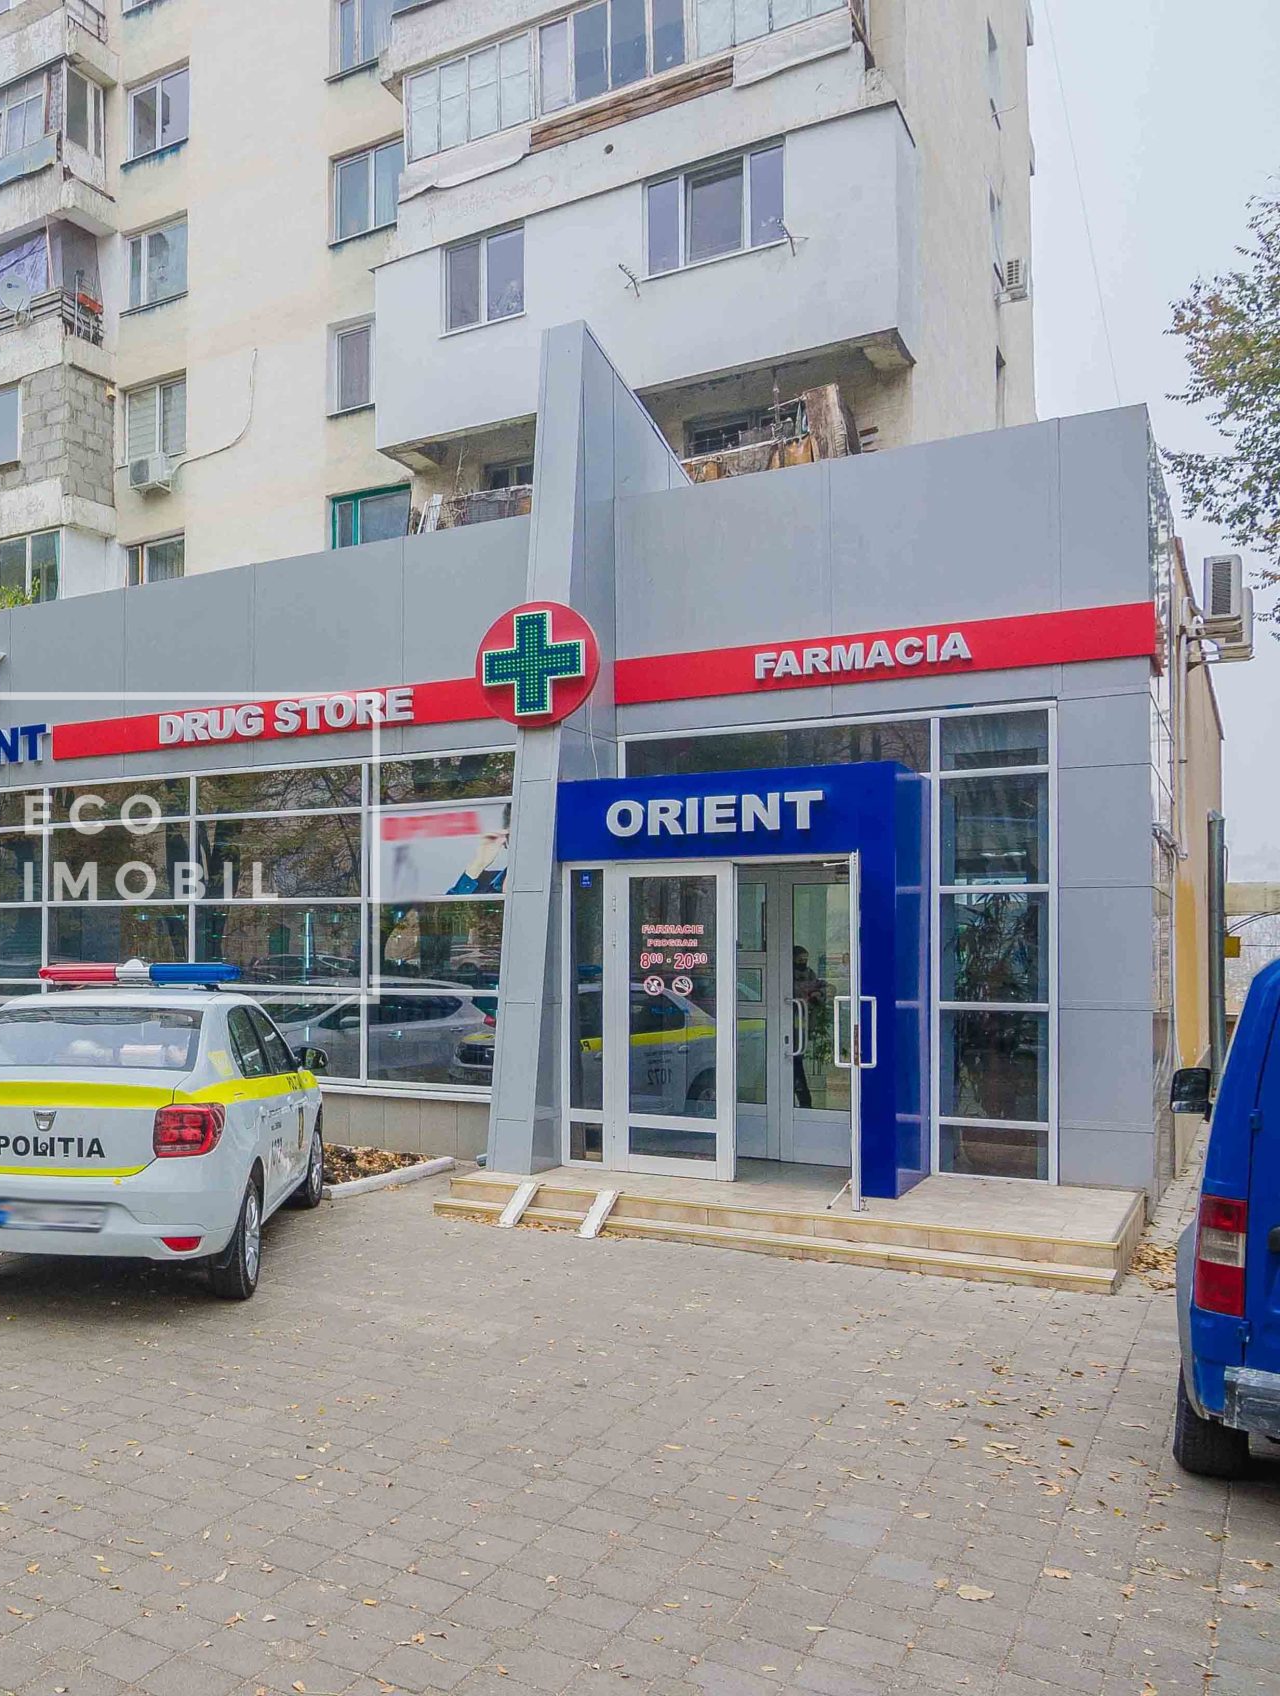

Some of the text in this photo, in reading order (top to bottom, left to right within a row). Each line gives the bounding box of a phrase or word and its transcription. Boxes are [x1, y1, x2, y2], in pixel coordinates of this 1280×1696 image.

[754, 632, 973, 680] FARMACIA
[159, 687, 414, 745] DRUG STORE
[606, 790, 824, 837] ORIENT
[641, 924, 704, 935] FARMACIE
[647, 938, 698, 947] PROGRAM
